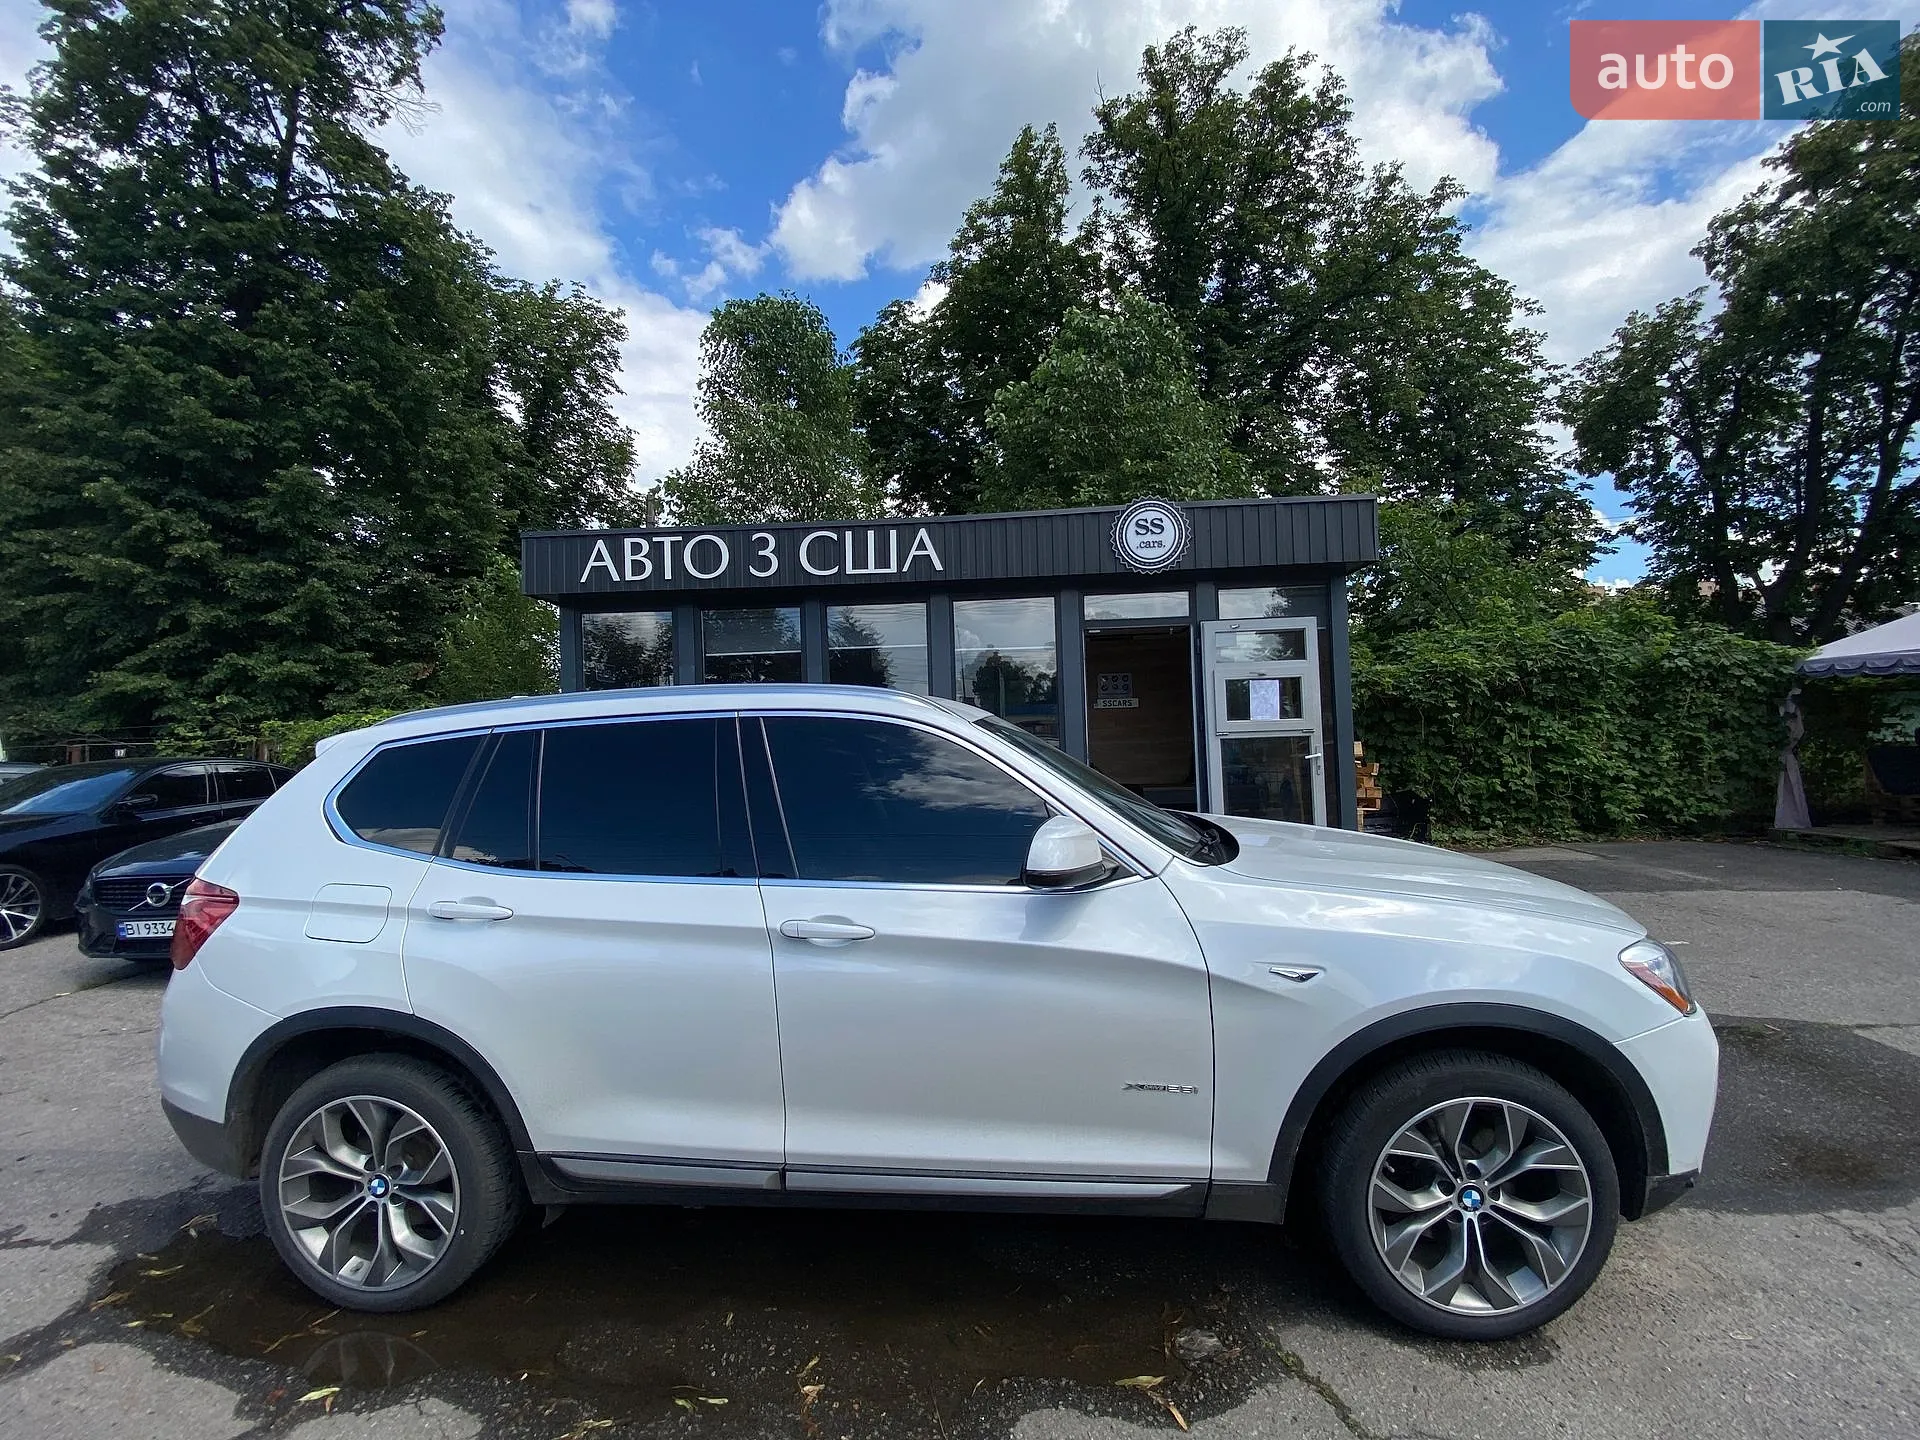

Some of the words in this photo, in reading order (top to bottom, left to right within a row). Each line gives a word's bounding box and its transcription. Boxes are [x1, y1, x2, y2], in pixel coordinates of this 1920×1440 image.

[1134, 517, 1165, 536] SS
[579, 534, 730, 584] АВТО
[799, 527, 944, 576] США
[1102, 699, 1133, 708] SSCARS
